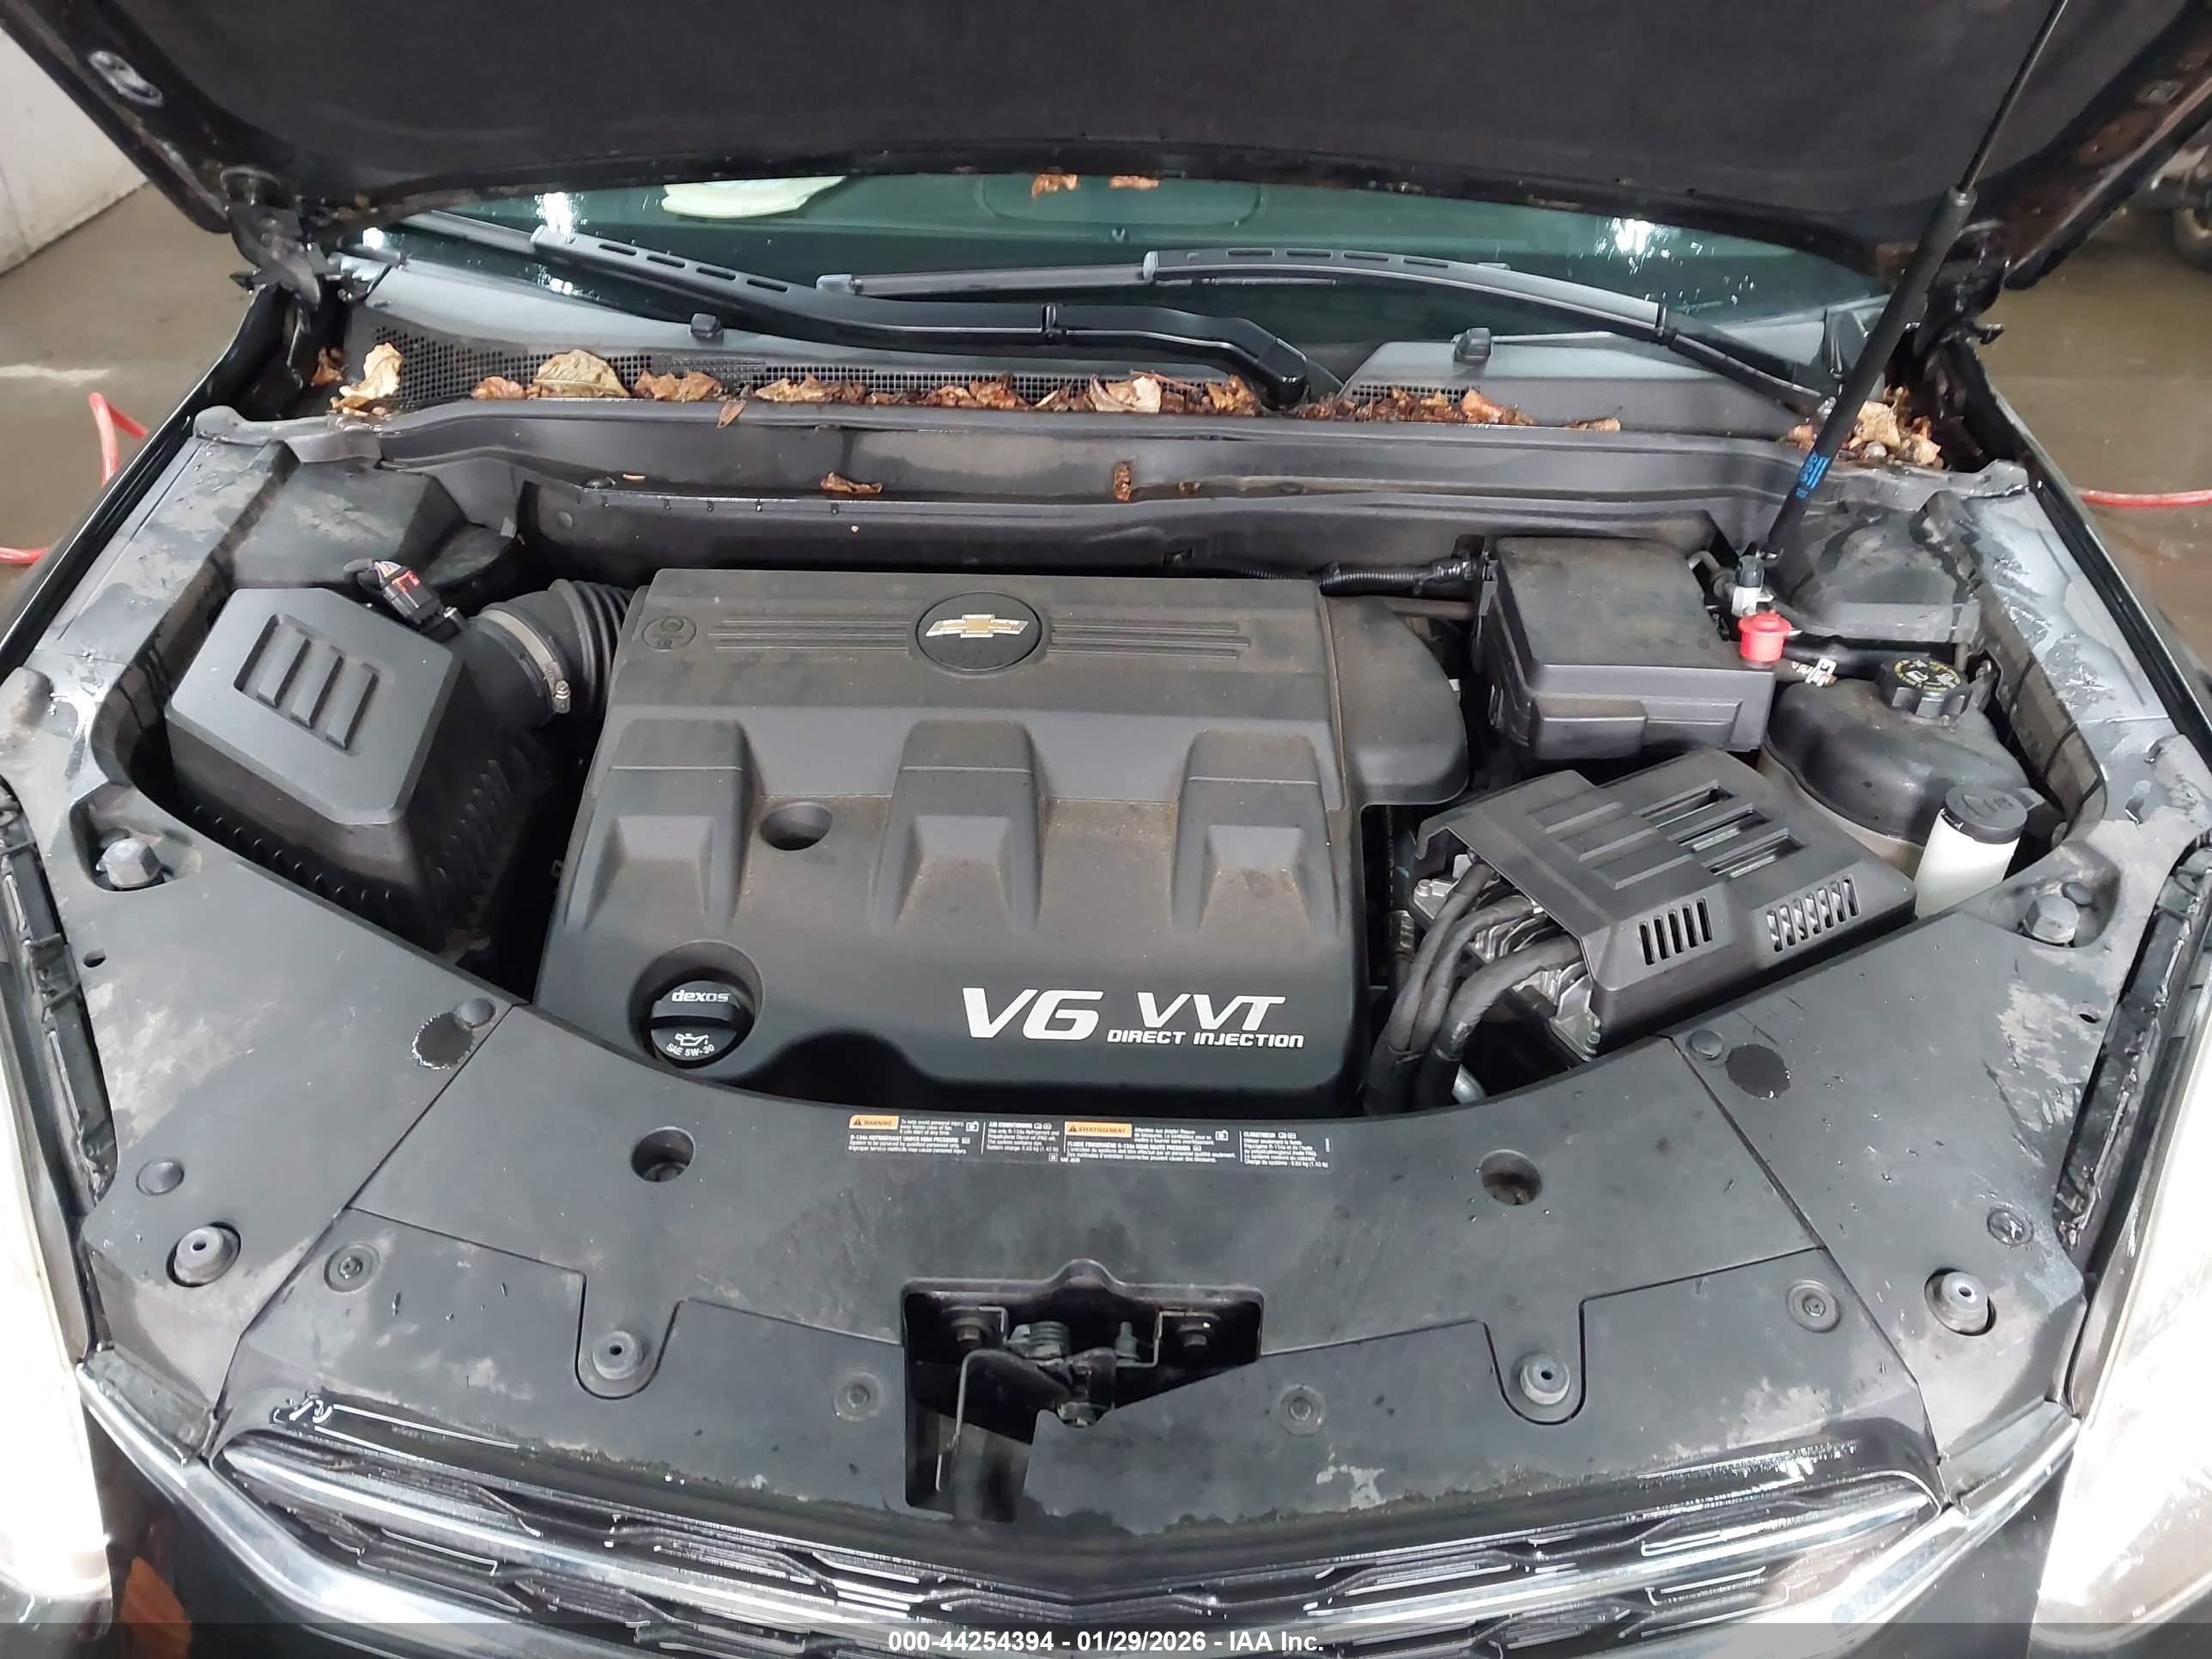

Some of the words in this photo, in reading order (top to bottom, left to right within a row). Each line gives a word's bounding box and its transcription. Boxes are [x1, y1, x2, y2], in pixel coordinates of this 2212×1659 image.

[672, 989, 731, 1003] dexos
[962, 987, 1104, 1041] V6
[1137, 991, 1286, 1032] VVT
[1106, 1028, 1187, 1045] DIRECT
[1192, 1031, 1304, 1048] INJECTION
[666, 1043, 684, 1056] SAE
[684, 1043, 715, 1057] 5W-30
